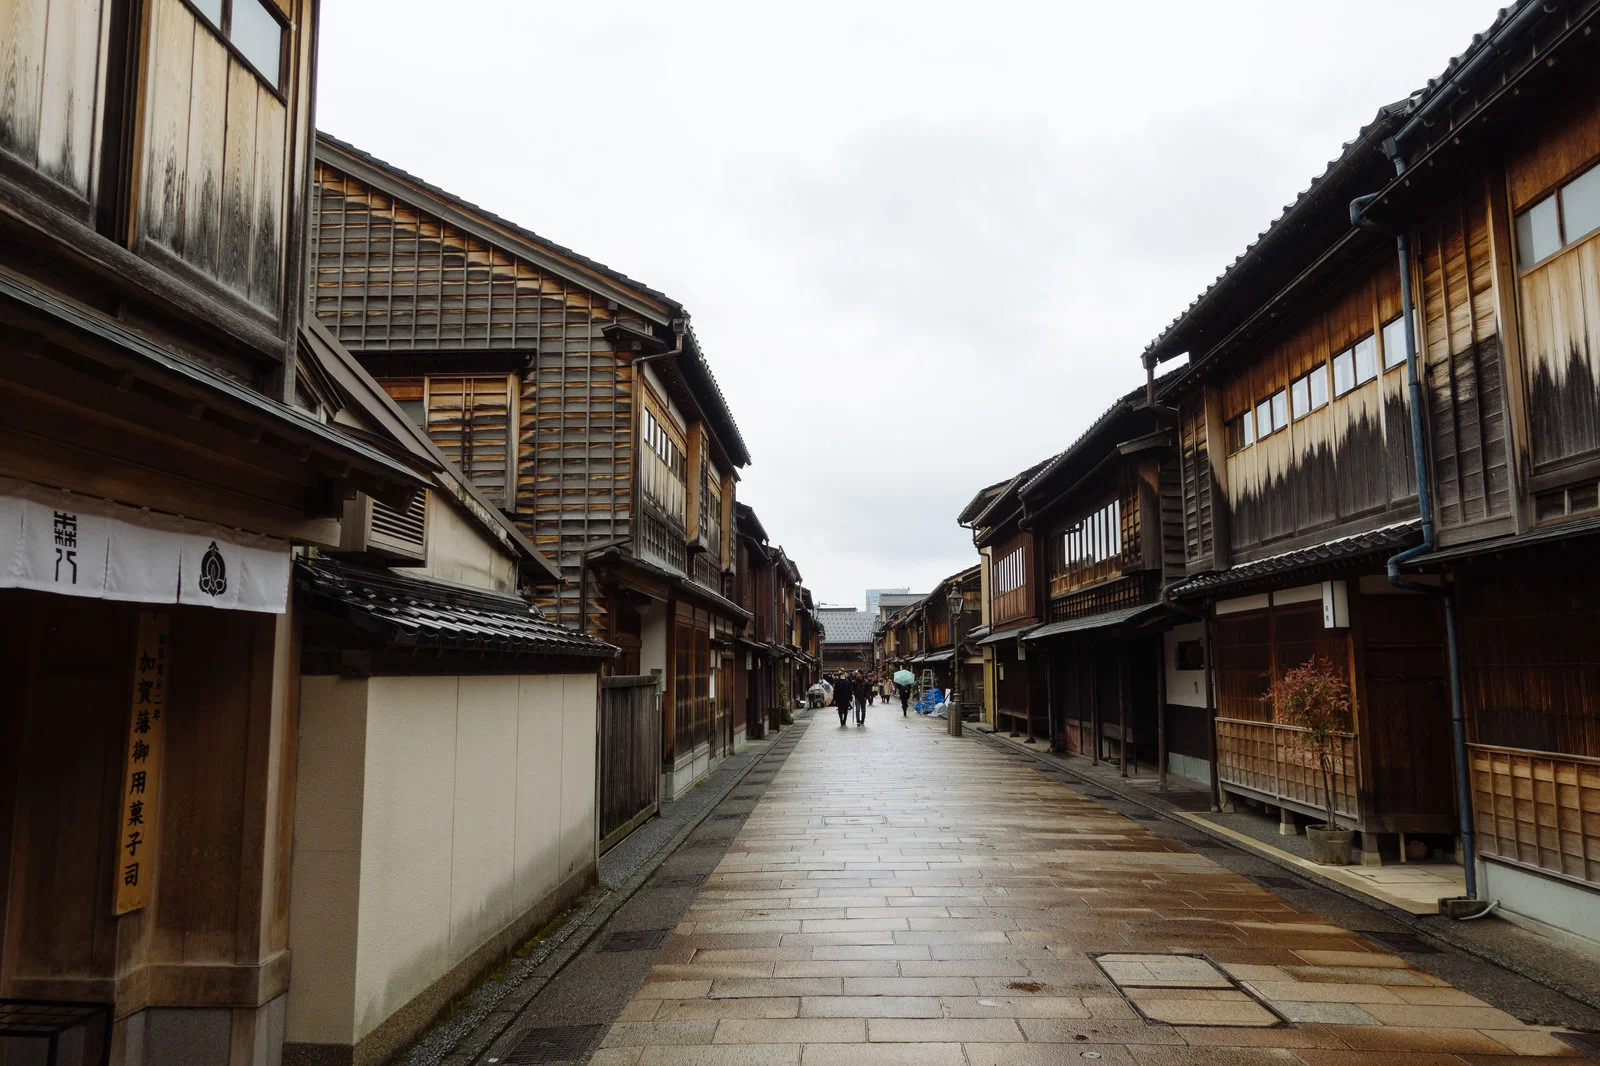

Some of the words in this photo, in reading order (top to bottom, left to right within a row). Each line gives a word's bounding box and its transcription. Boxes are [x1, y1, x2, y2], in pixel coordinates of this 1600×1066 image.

[124, 651, 156, 887] 加賀藩御用菓子司
